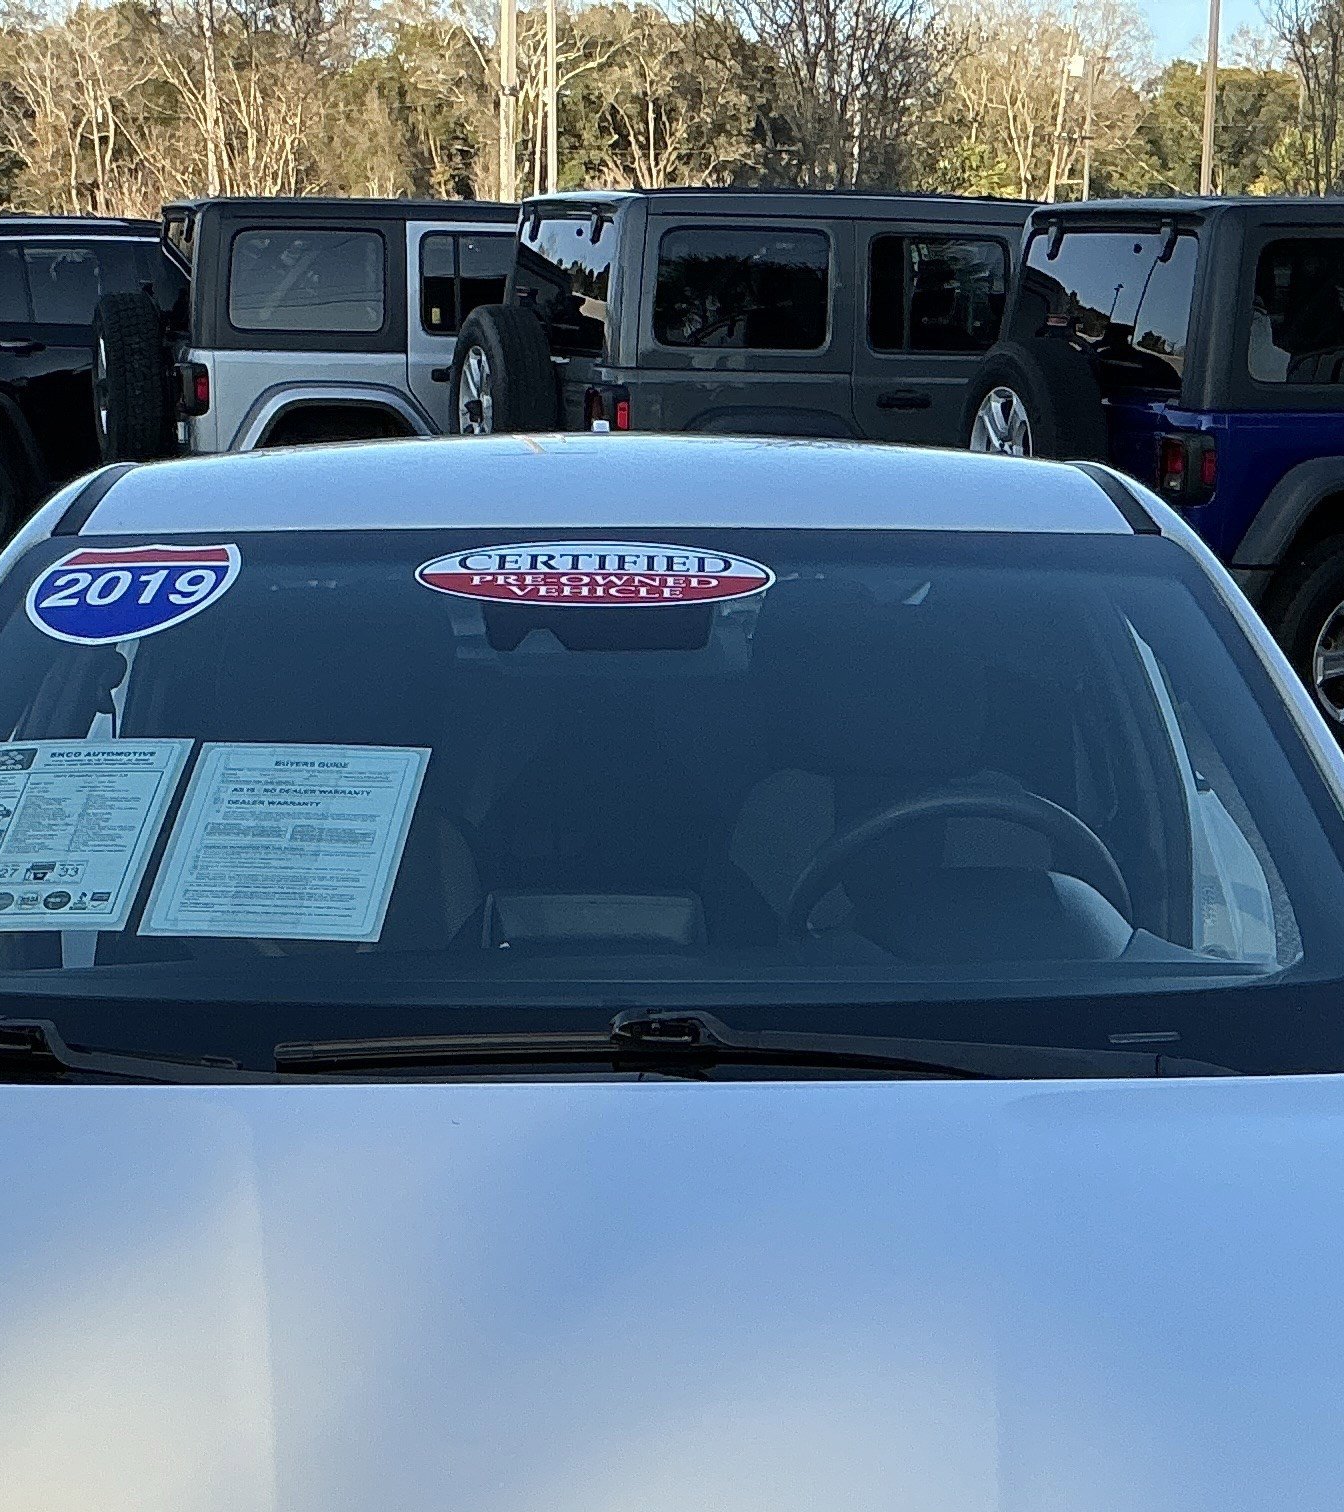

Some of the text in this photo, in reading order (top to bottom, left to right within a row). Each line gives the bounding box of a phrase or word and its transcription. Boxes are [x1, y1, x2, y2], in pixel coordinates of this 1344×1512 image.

[458, 553, 733, 573] CERTIFIED
[470, 574, 720, 589] PRE-OWNED
[39, 569, 217, 608] 2019
[506, 586, 684, 599] VEHICLE
[274, 760, 315, 768] BUYERS
[319, 789, 372, 797] WARRANTY
[58, 866, 80, 878] 33
